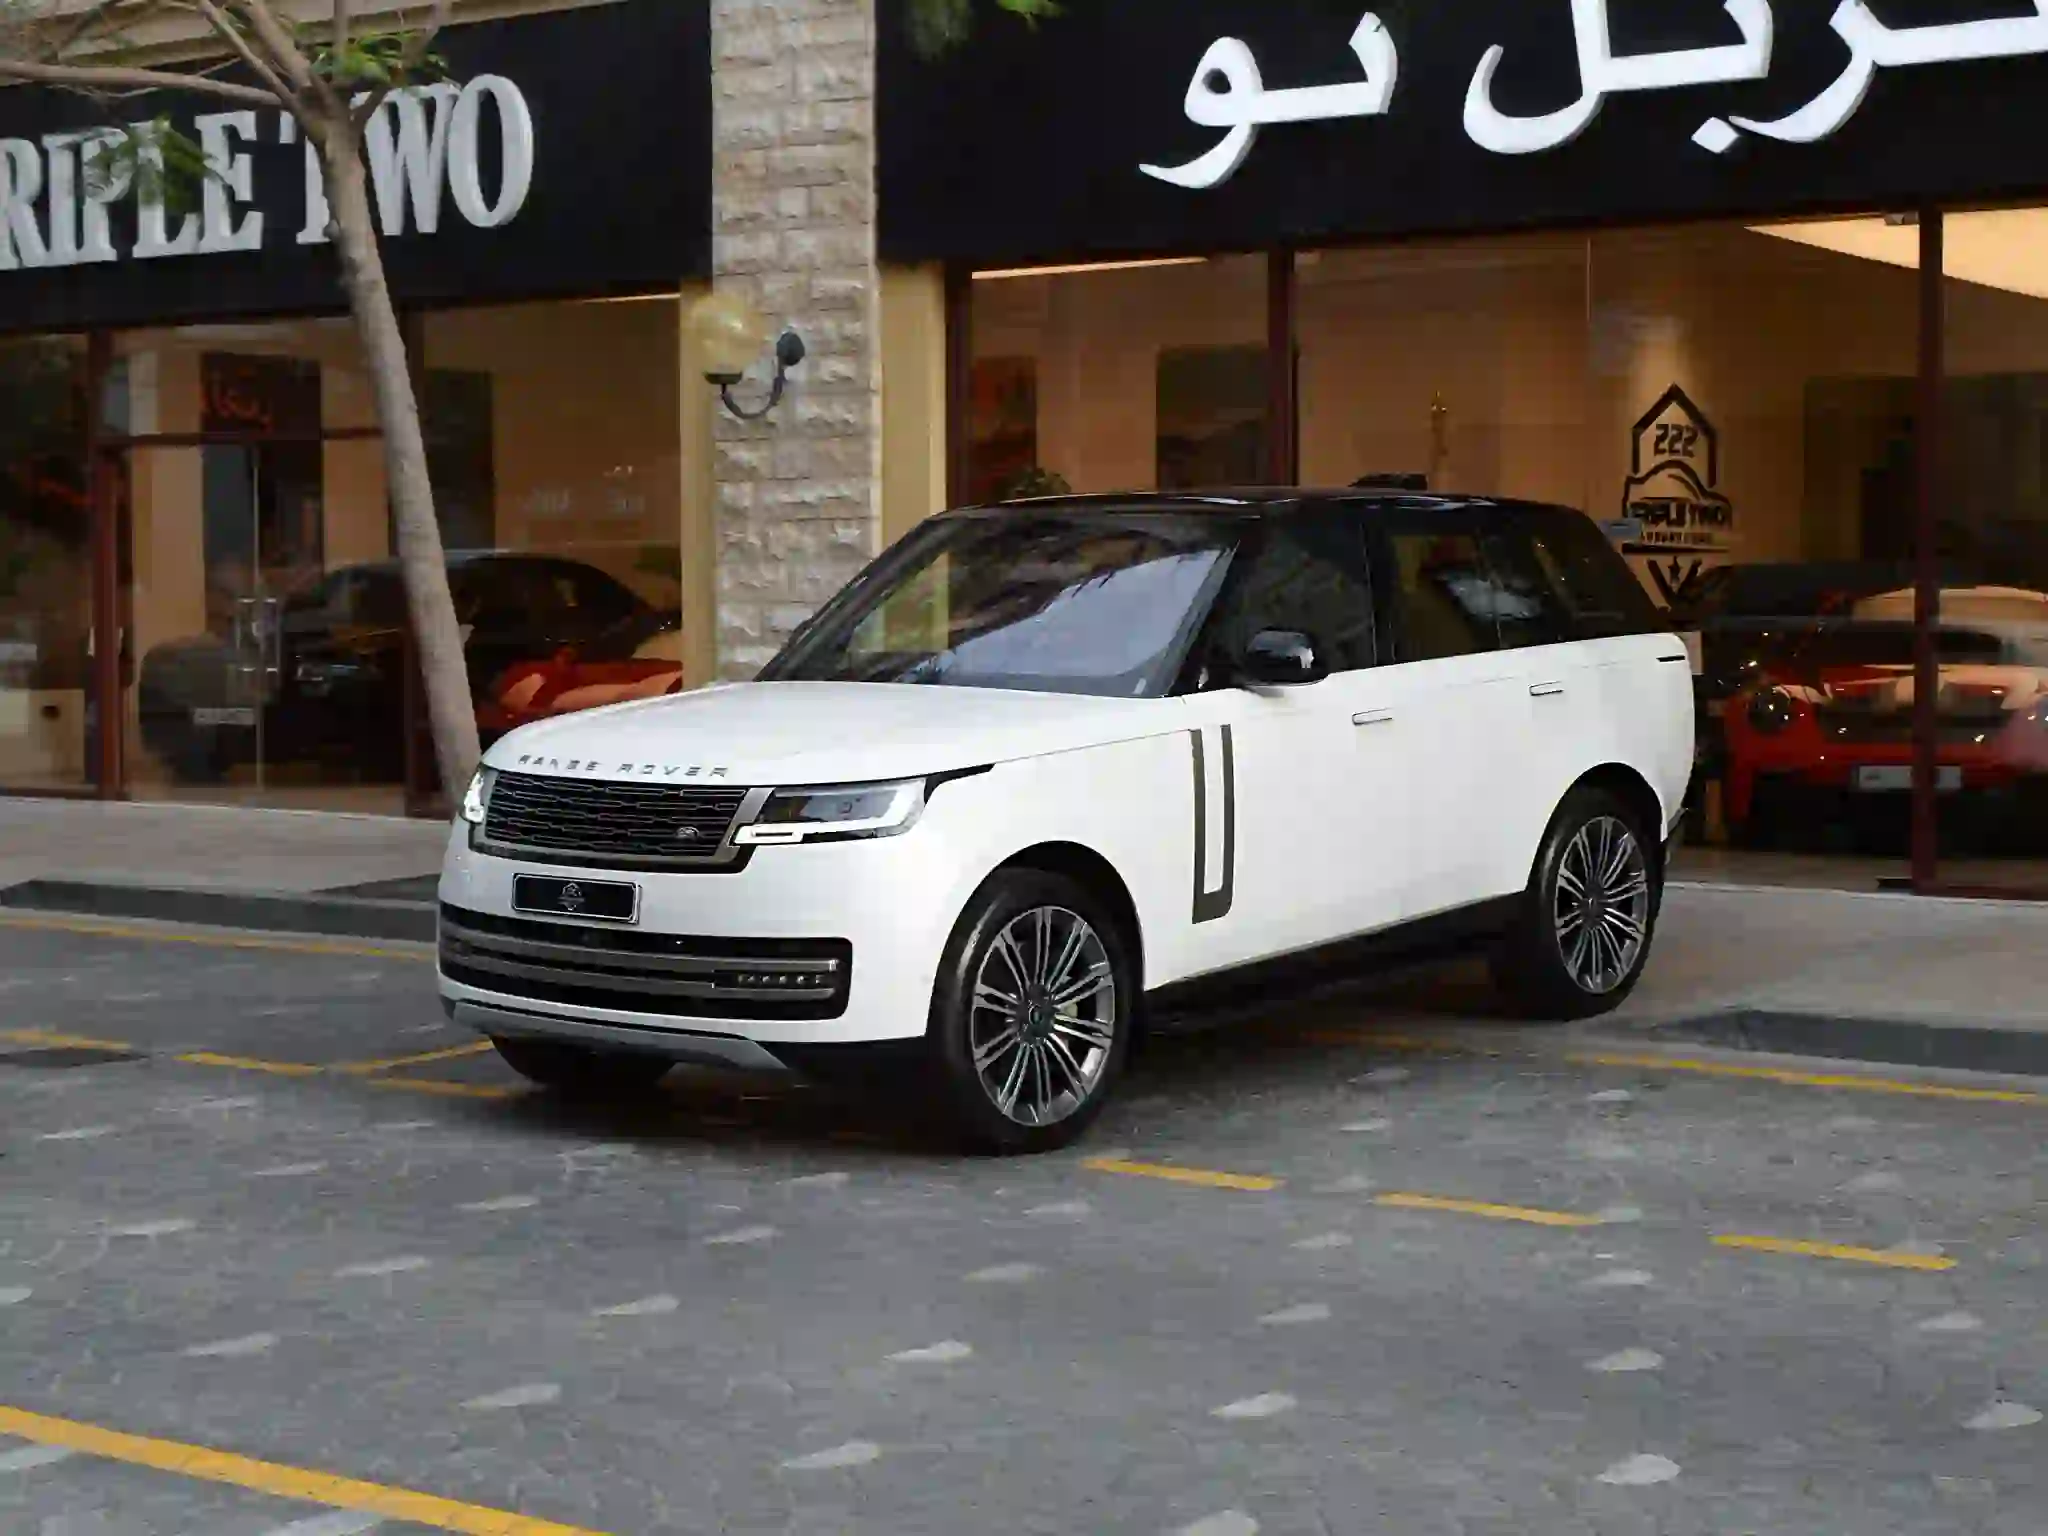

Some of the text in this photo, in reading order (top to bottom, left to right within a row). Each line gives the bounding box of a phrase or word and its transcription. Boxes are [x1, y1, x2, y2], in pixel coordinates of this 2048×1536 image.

[1653, 423, 1698, 458] 222
[518, 754, 730, 778] RANGE ROVER
